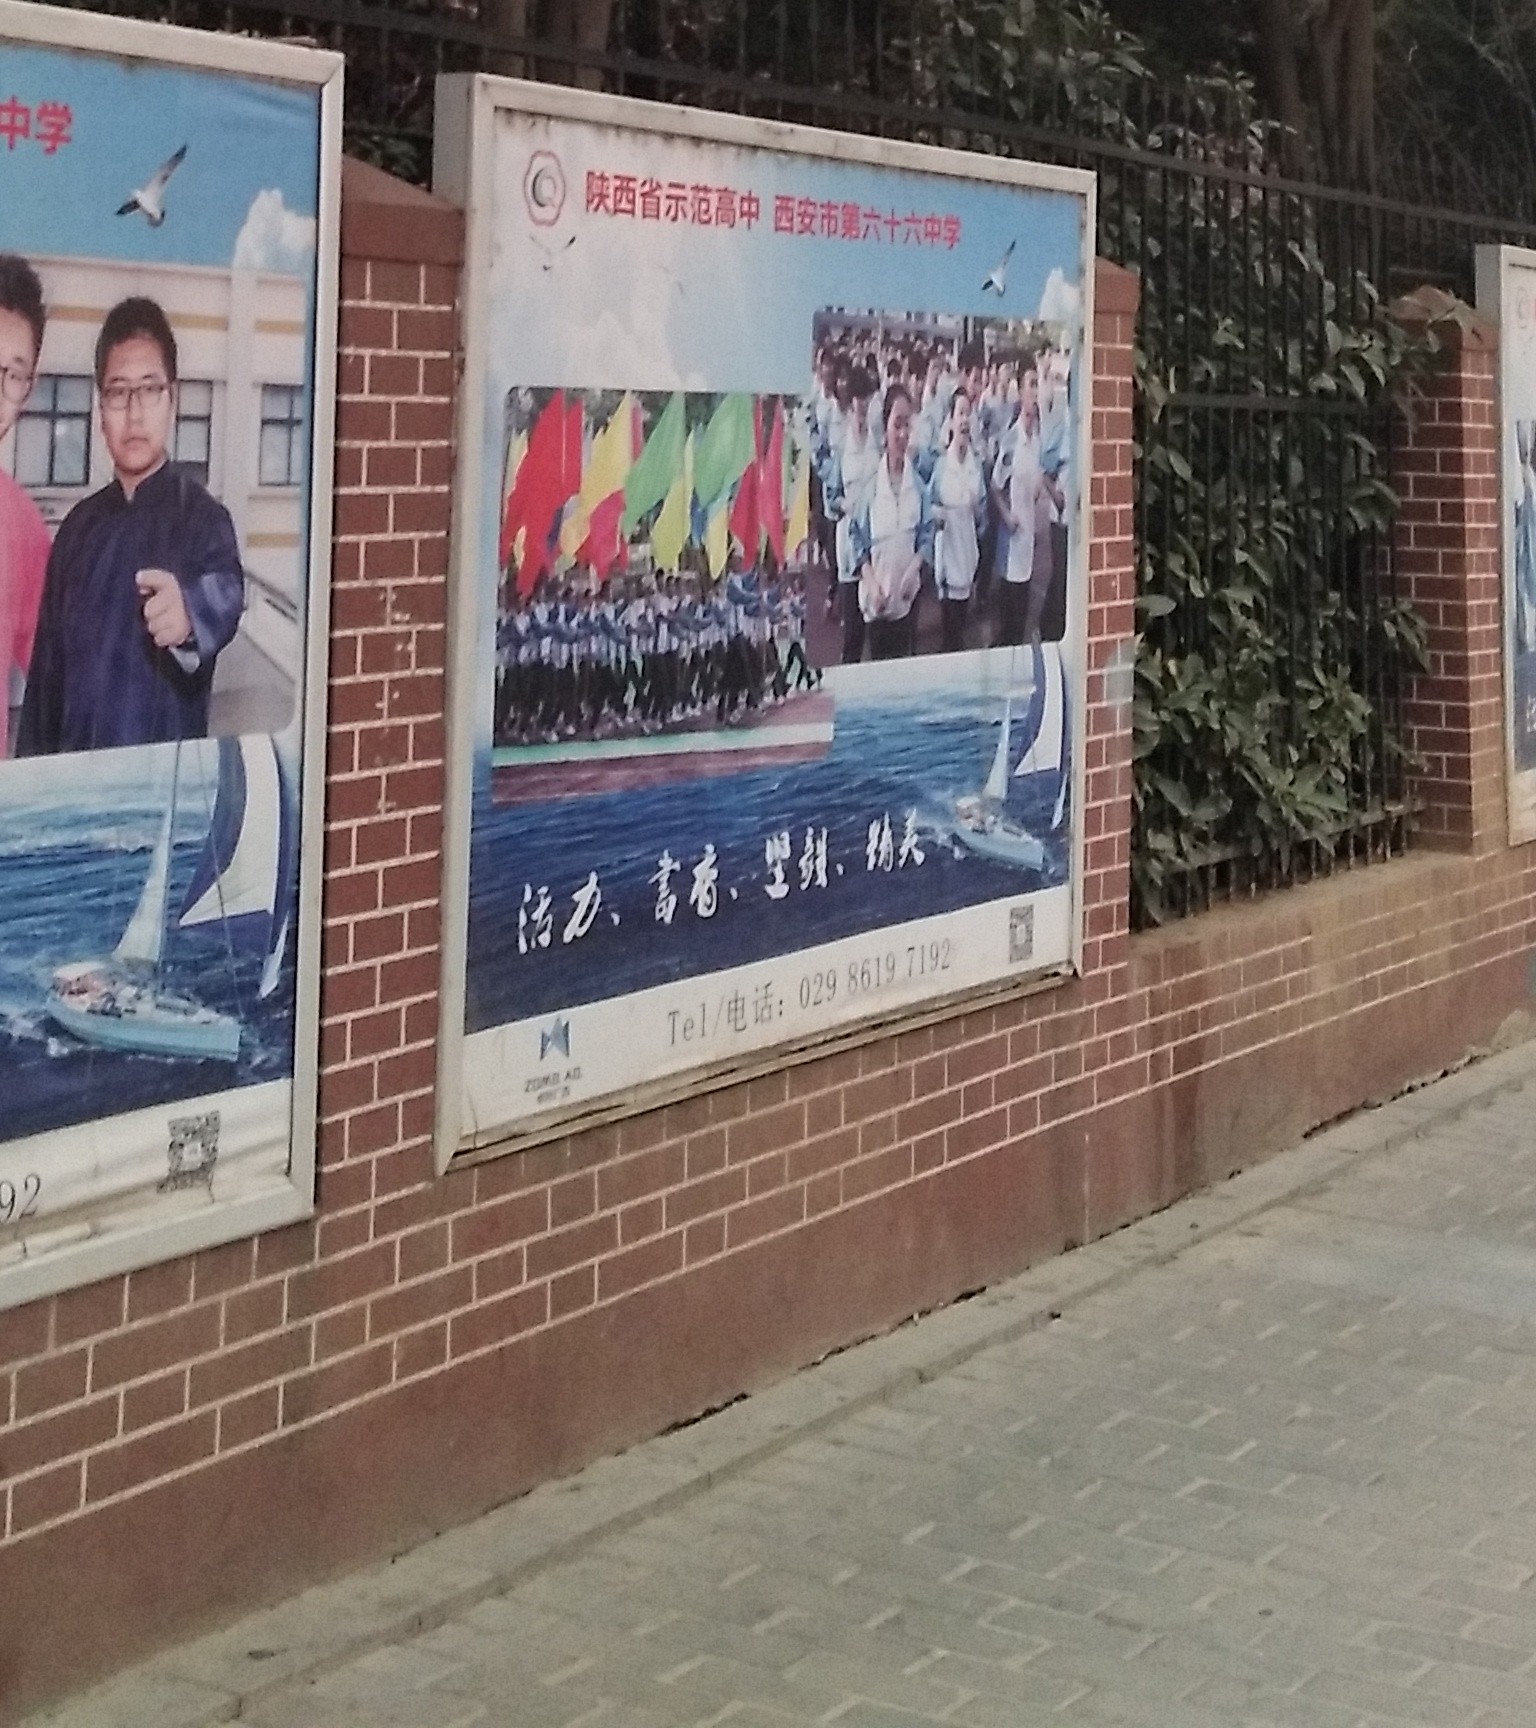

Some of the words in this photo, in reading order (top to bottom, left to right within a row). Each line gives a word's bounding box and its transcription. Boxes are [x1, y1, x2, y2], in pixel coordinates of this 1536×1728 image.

[584, 170, 761, 230] 陕西省示范高中
[773, 194, 963, 251] 西安市第六十六中学
[799, 968, 838, 1010] 029
[848, 950, 896, 996] 8619
[907, 937, 952, 978] 7192
